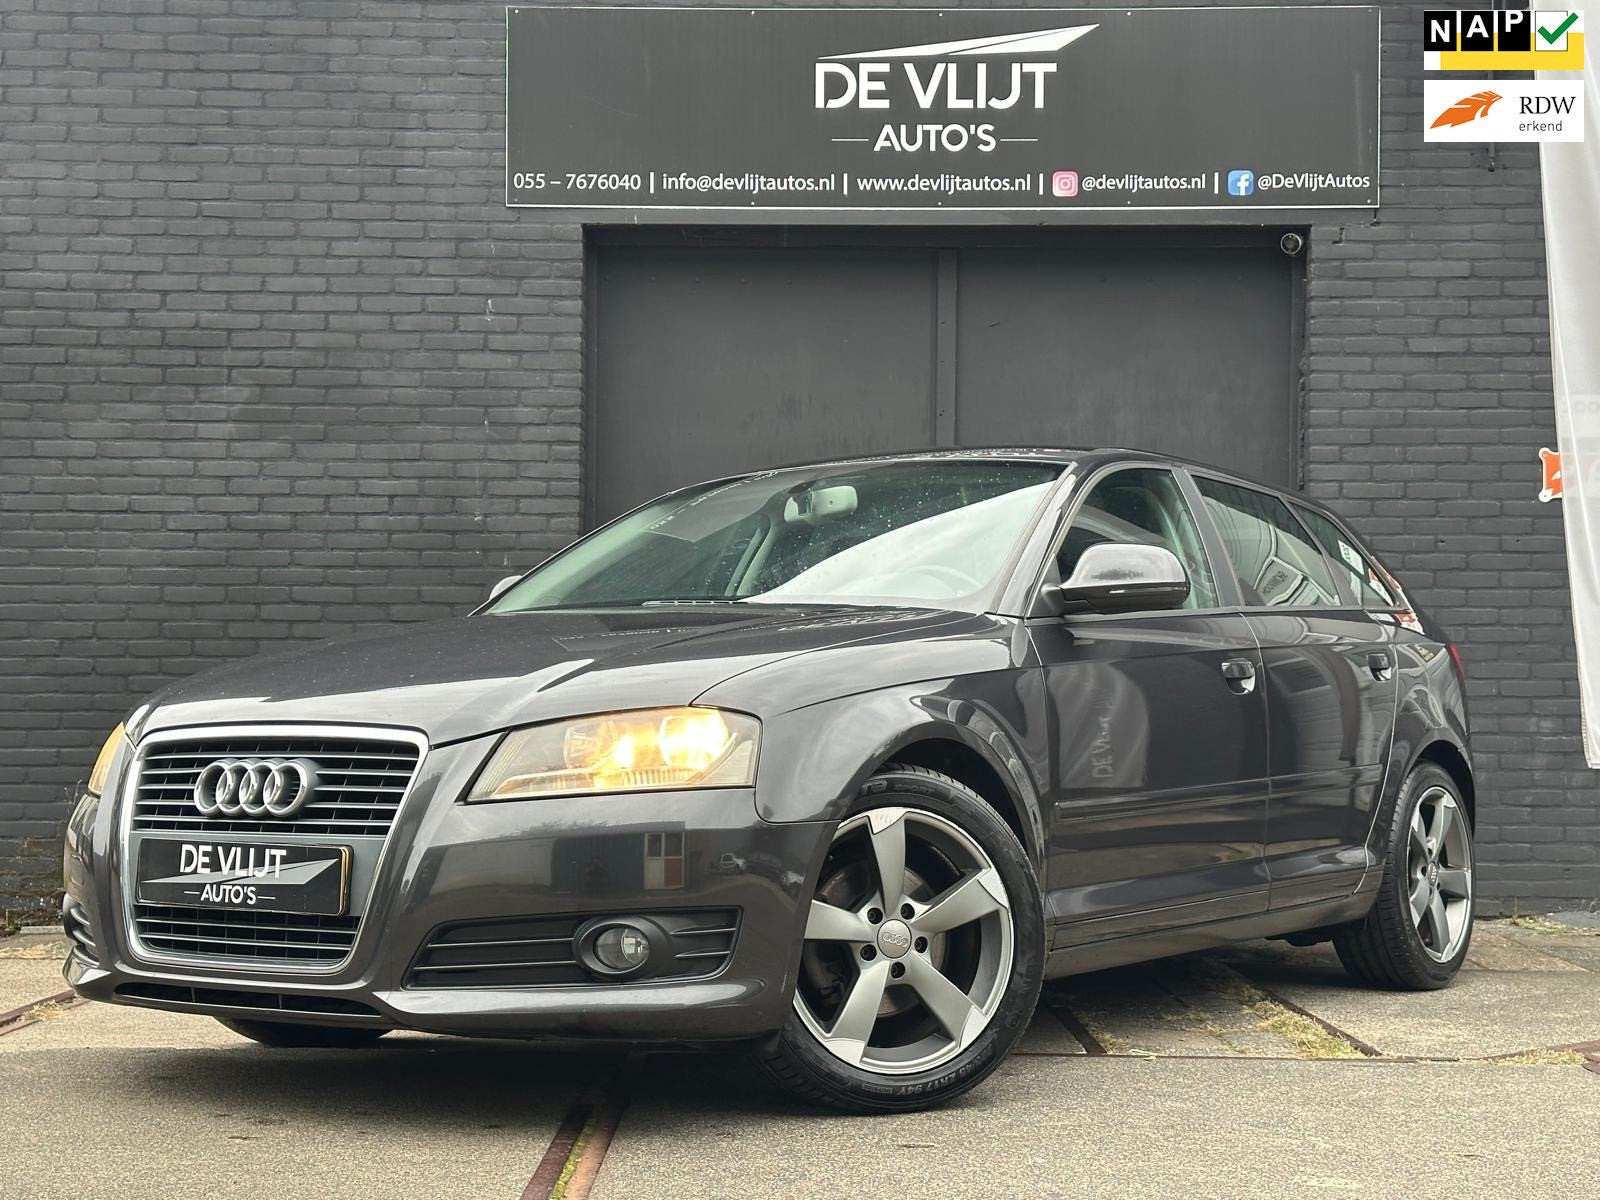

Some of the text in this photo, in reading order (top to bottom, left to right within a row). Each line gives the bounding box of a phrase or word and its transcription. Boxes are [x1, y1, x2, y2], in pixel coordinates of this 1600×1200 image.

[815, 62, 1058, 110] DE VLIJT
[873, 123, 997, 153] AUTO'S
[513, 172, 546, 189] 055
[565, 173, 642, 190] 7676040
[662, 173, 835, 195] info@devlijtautos.nl
[856, 173, 1031, 195] www.devlijtautos.nl
[1081, 172, 1206, 193] @devlijtautos.nl
[1257, 173, 1371, 192] @DeVlijtAutos
[180, 844, 287, 879] DE VLIJT
[200, 884, 257, 905] AUTO'S
